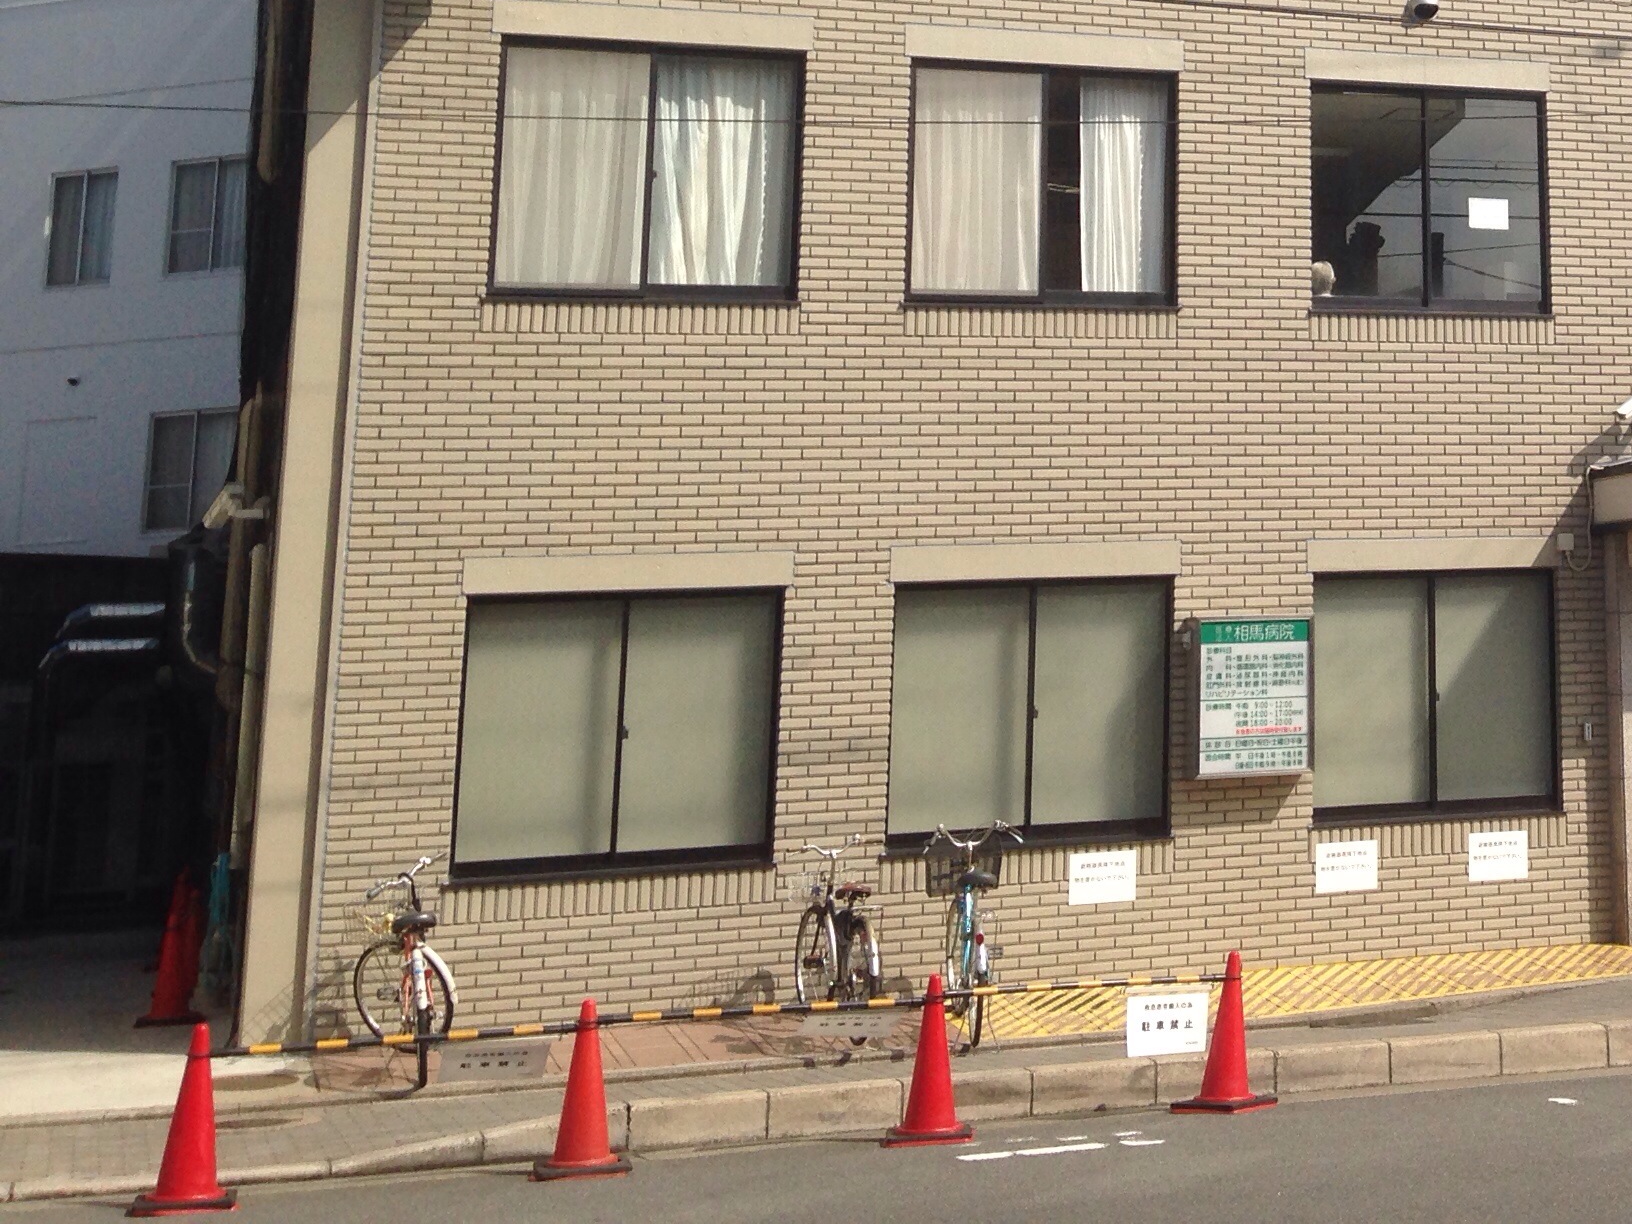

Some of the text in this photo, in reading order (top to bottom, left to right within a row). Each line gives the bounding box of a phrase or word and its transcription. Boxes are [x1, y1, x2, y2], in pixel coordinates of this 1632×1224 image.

[1234, 623, 1295, 642] 相馬病院
[1141, 1019, 1194, 1032] 駐車禁止
